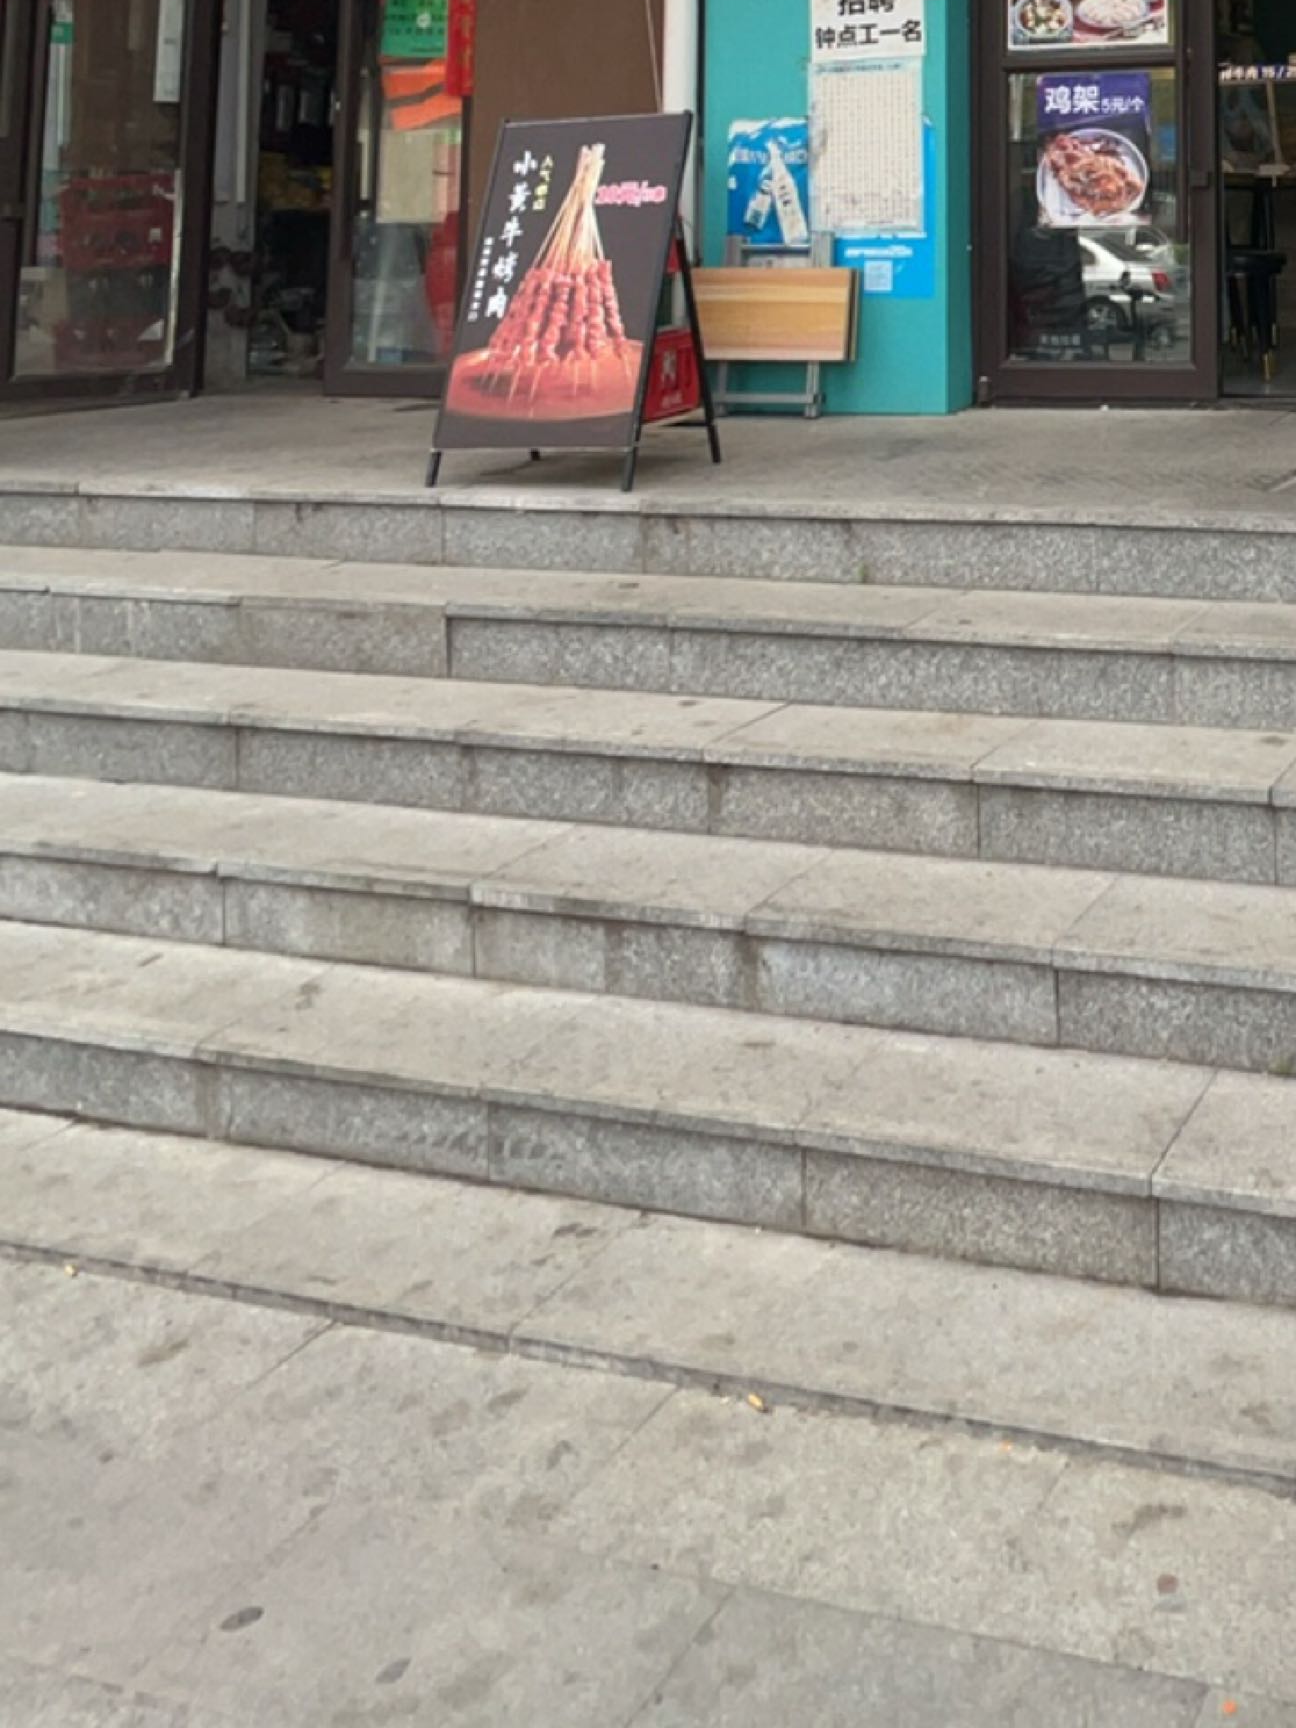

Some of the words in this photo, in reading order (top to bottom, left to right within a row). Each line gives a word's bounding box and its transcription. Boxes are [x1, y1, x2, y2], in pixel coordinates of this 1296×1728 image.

[815, 19, 922, 50] 钟点工一名
[1043, 83, 1100, 115] 鸡架
